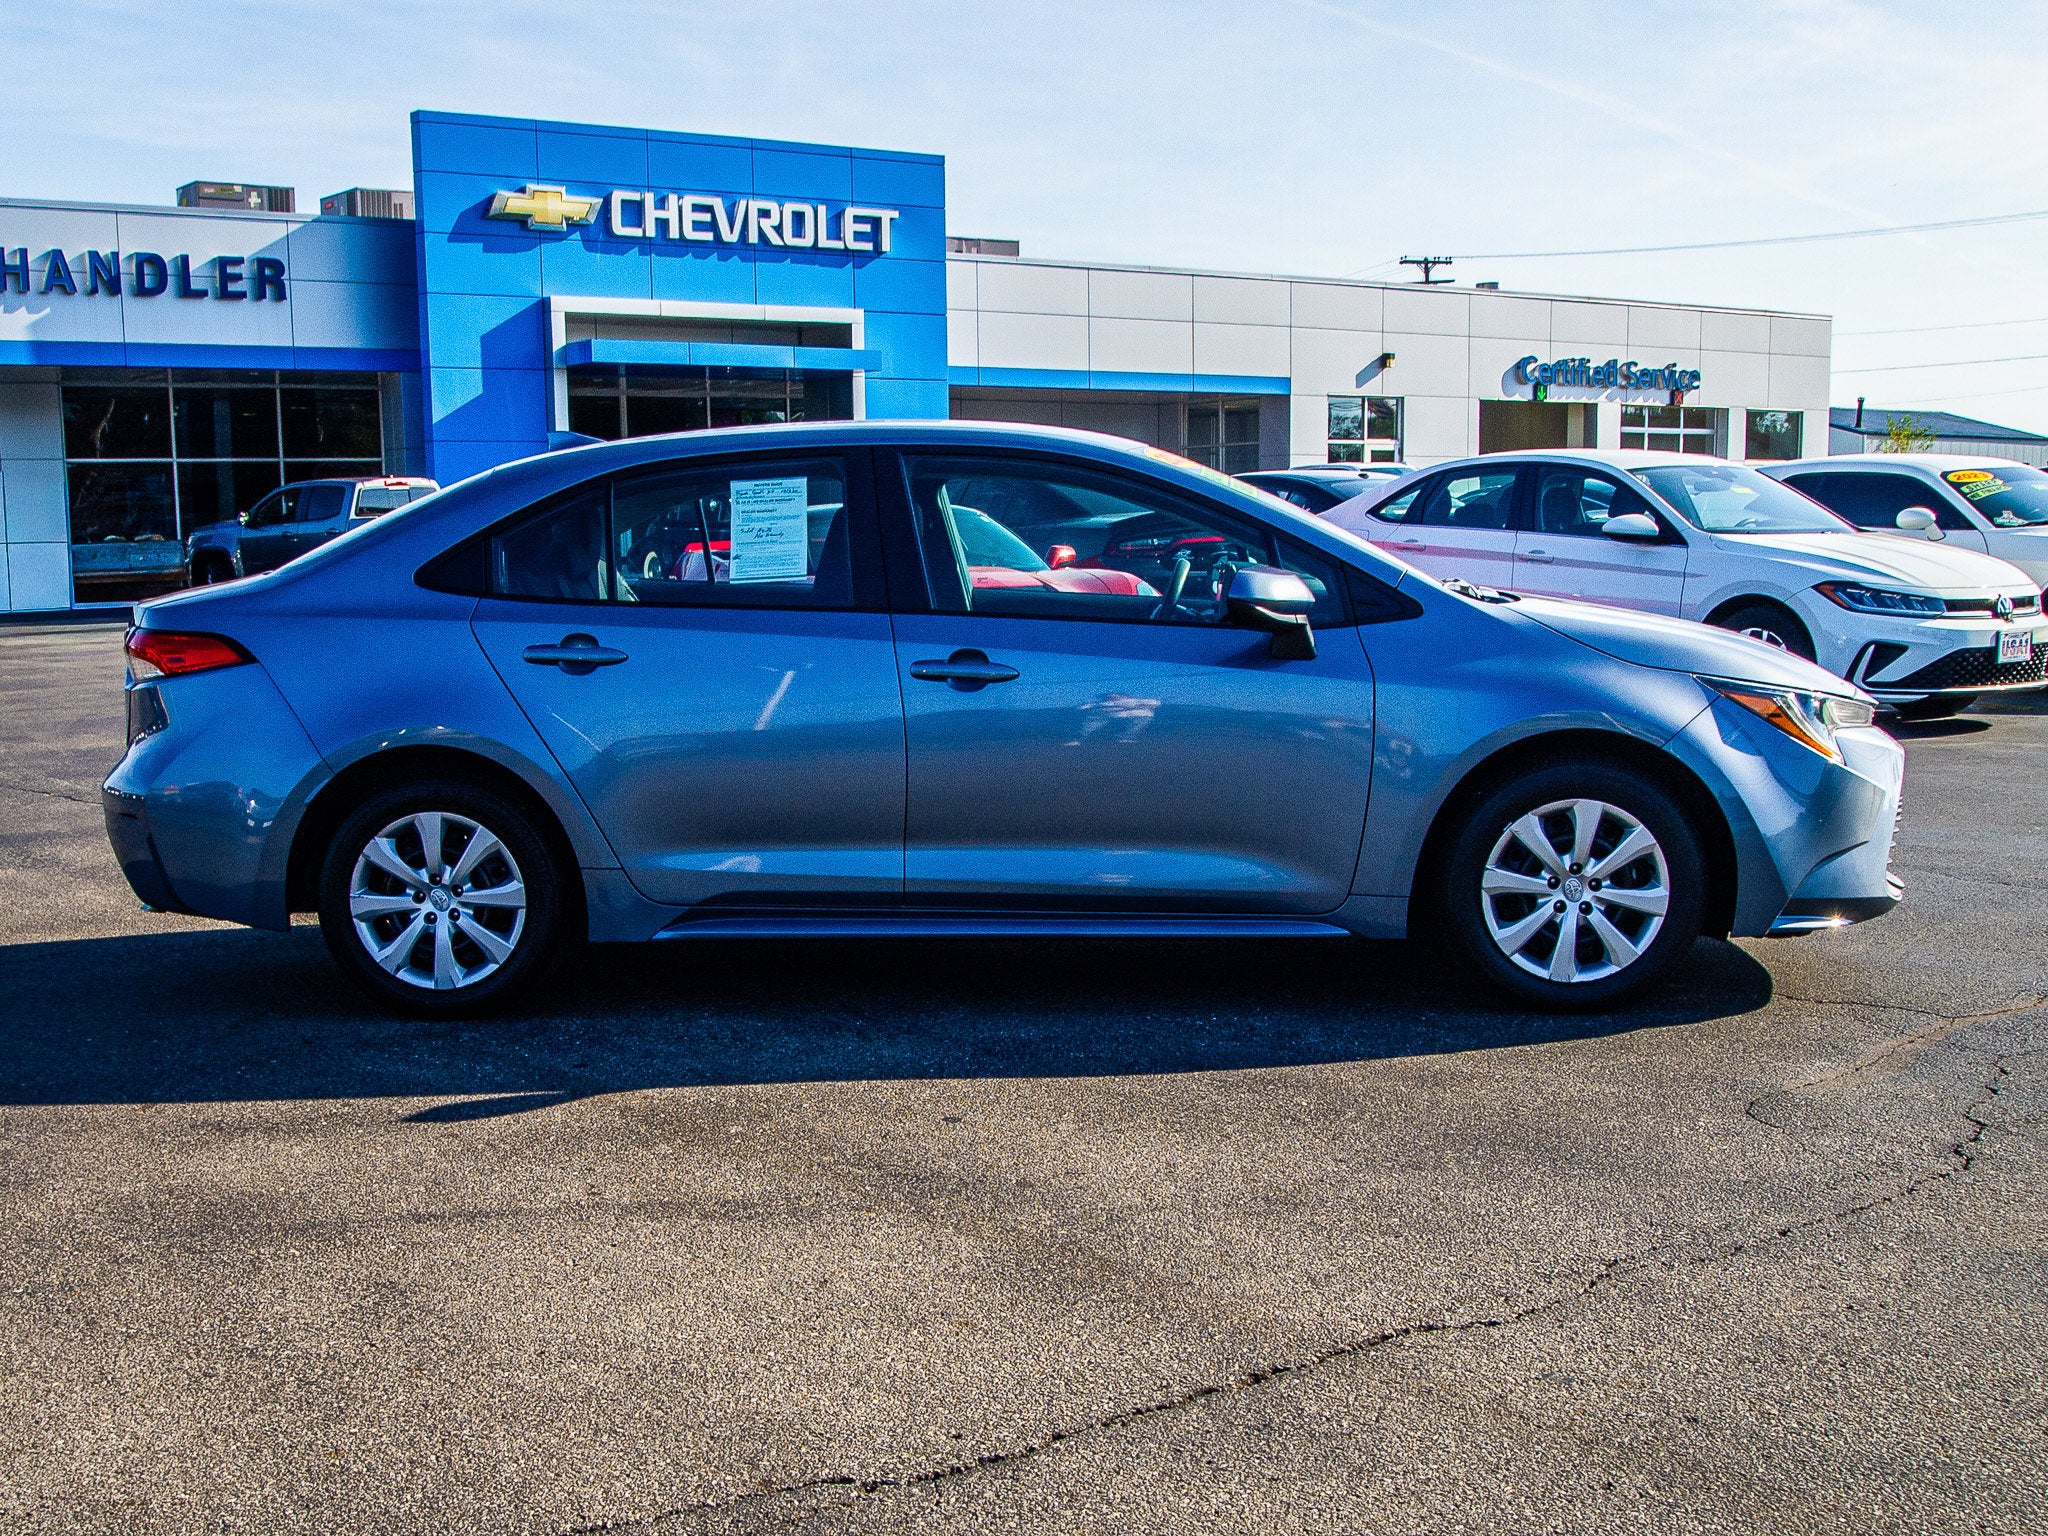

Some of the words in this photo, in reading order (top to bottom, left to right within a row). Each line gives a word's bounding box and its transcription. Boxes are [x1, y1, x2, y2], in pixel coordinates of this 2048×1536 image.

[611, 190, 899, 252] CHEVROLET
[1520, 355, 1618, 388] Certified
[1626, 361, 1701, 390] Service
[2001, 637, 2030, 657] USA1
